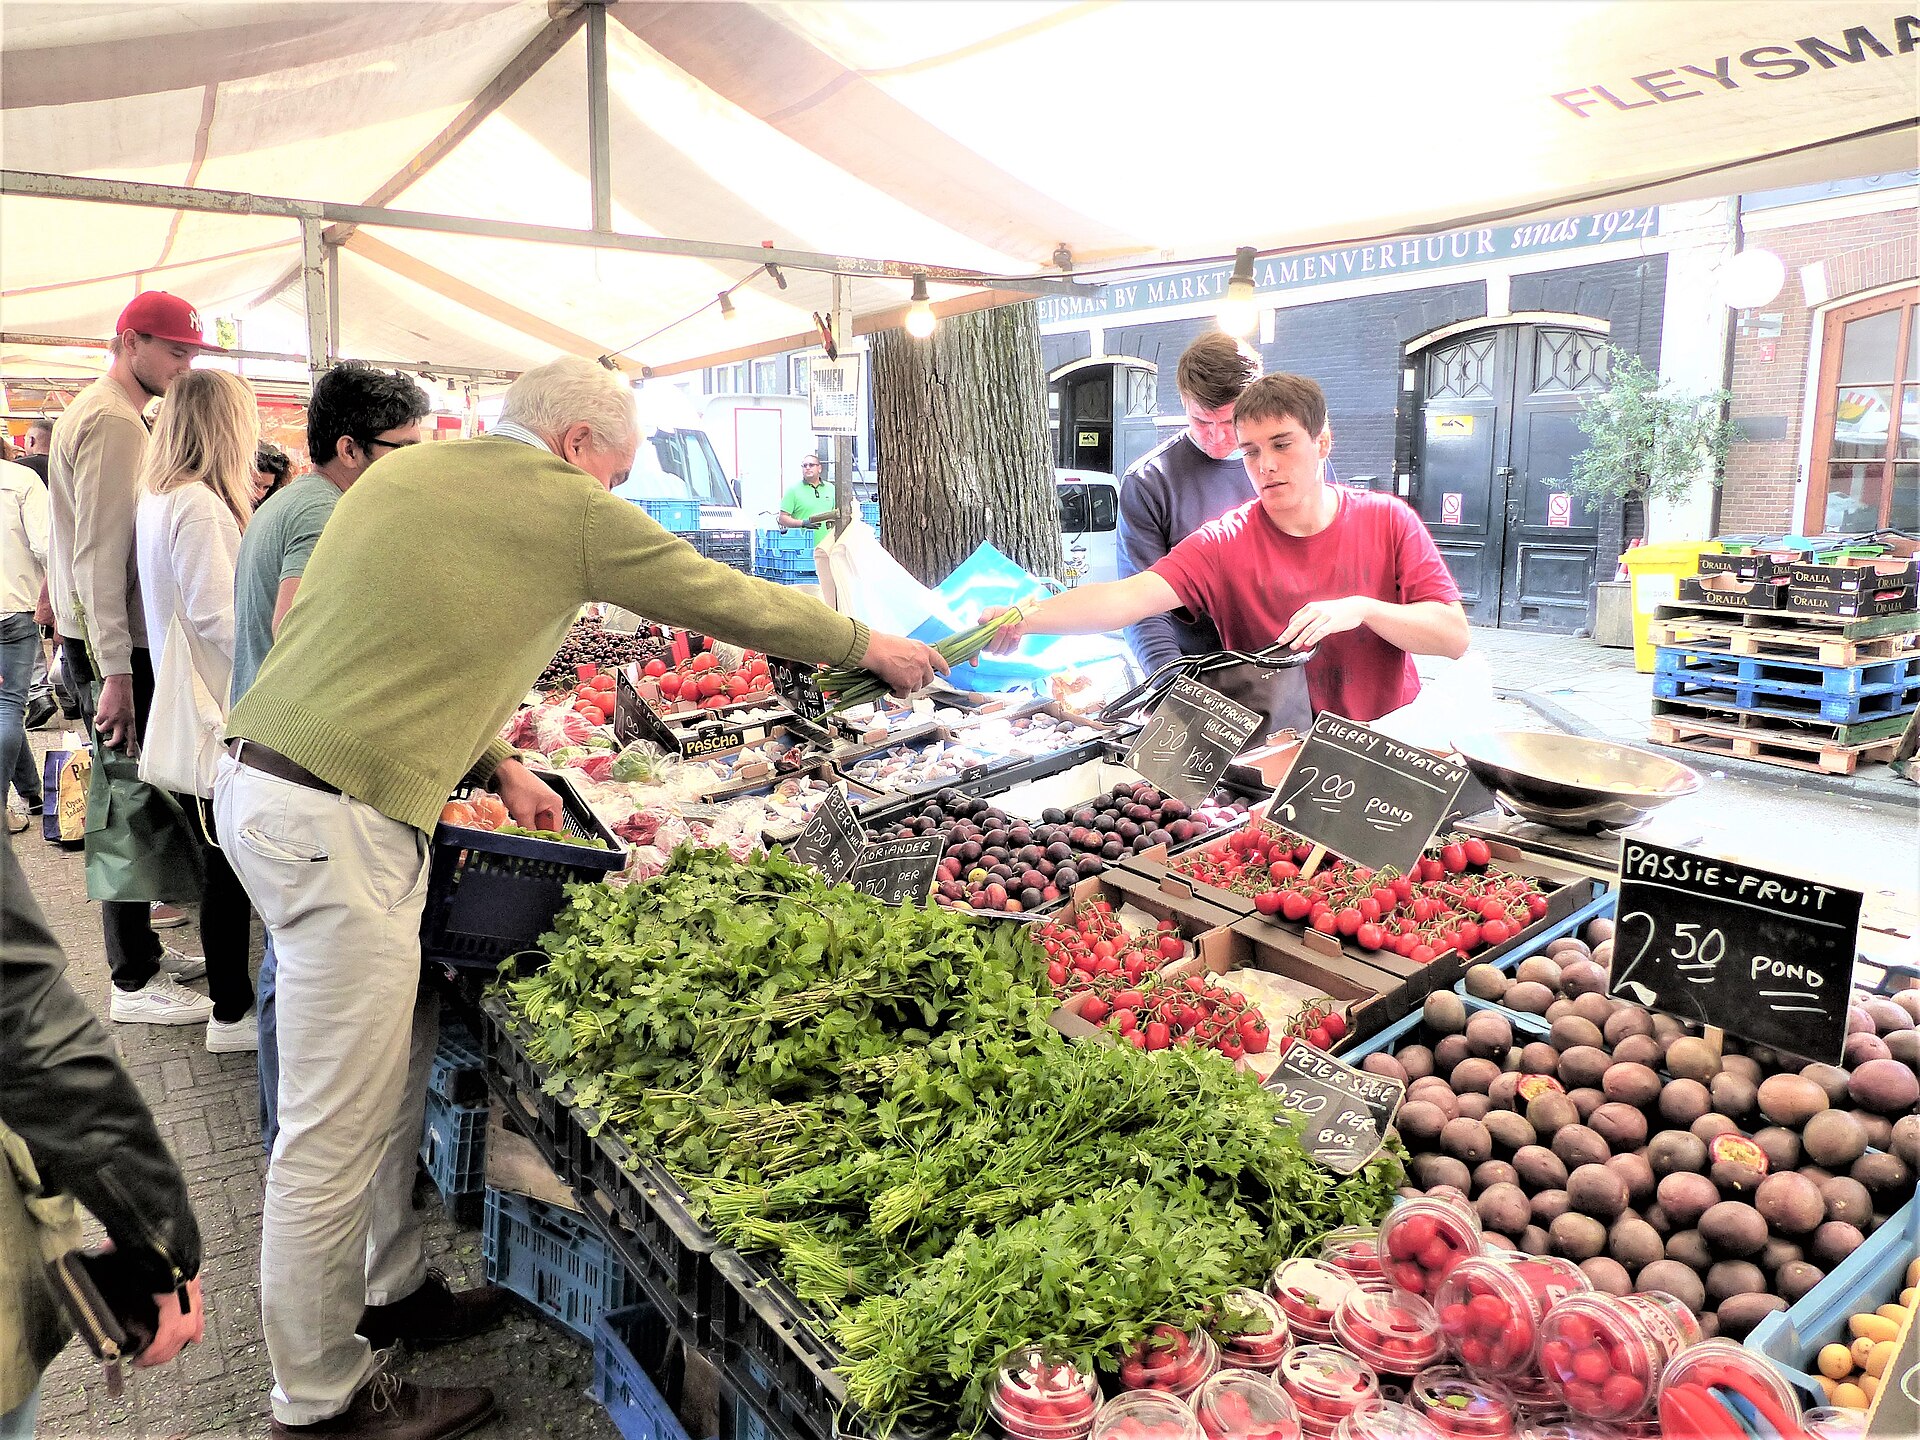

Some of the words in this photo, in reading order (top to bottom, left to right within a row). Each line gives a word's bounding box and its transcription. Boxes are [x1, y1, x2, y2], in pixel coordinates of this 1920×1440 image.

[1114, 286, 1138, 309] BV
[1147, 227, 1495, 304] MARKTRAMENVERHUUR
[1510, 214, 1580, 249] sinds
[1587, 205, 1655, 243] 1924
[1699, 559, 1732, 571] ORALIA
[1792, 570, 1831, 584] ORALIA
[1876, 577, 1904, 588] ORALIA
[1702, 591, 1748, 606] ORALIA
[1791, 594, 1829, 608] ORALIA
[1874, 601, 1902, 613] ORALIA
[1174, 679, 1204, 698] ZOETE
[686, 733, 739, 755] PASCHA
[1315, 717, 1382, 752] CHERRY
[1384, 741, 1464, 783] TOMATEN
[828, 788, 856, 836] PEPERS
[1365, 796, 1414, 824] POND
[829, 848, 844, 873] PER
[898, 869, 920, 884] PER
[1750, 955, 1824, 988] POND
[1336, 1110, 1377, 1132] PER
